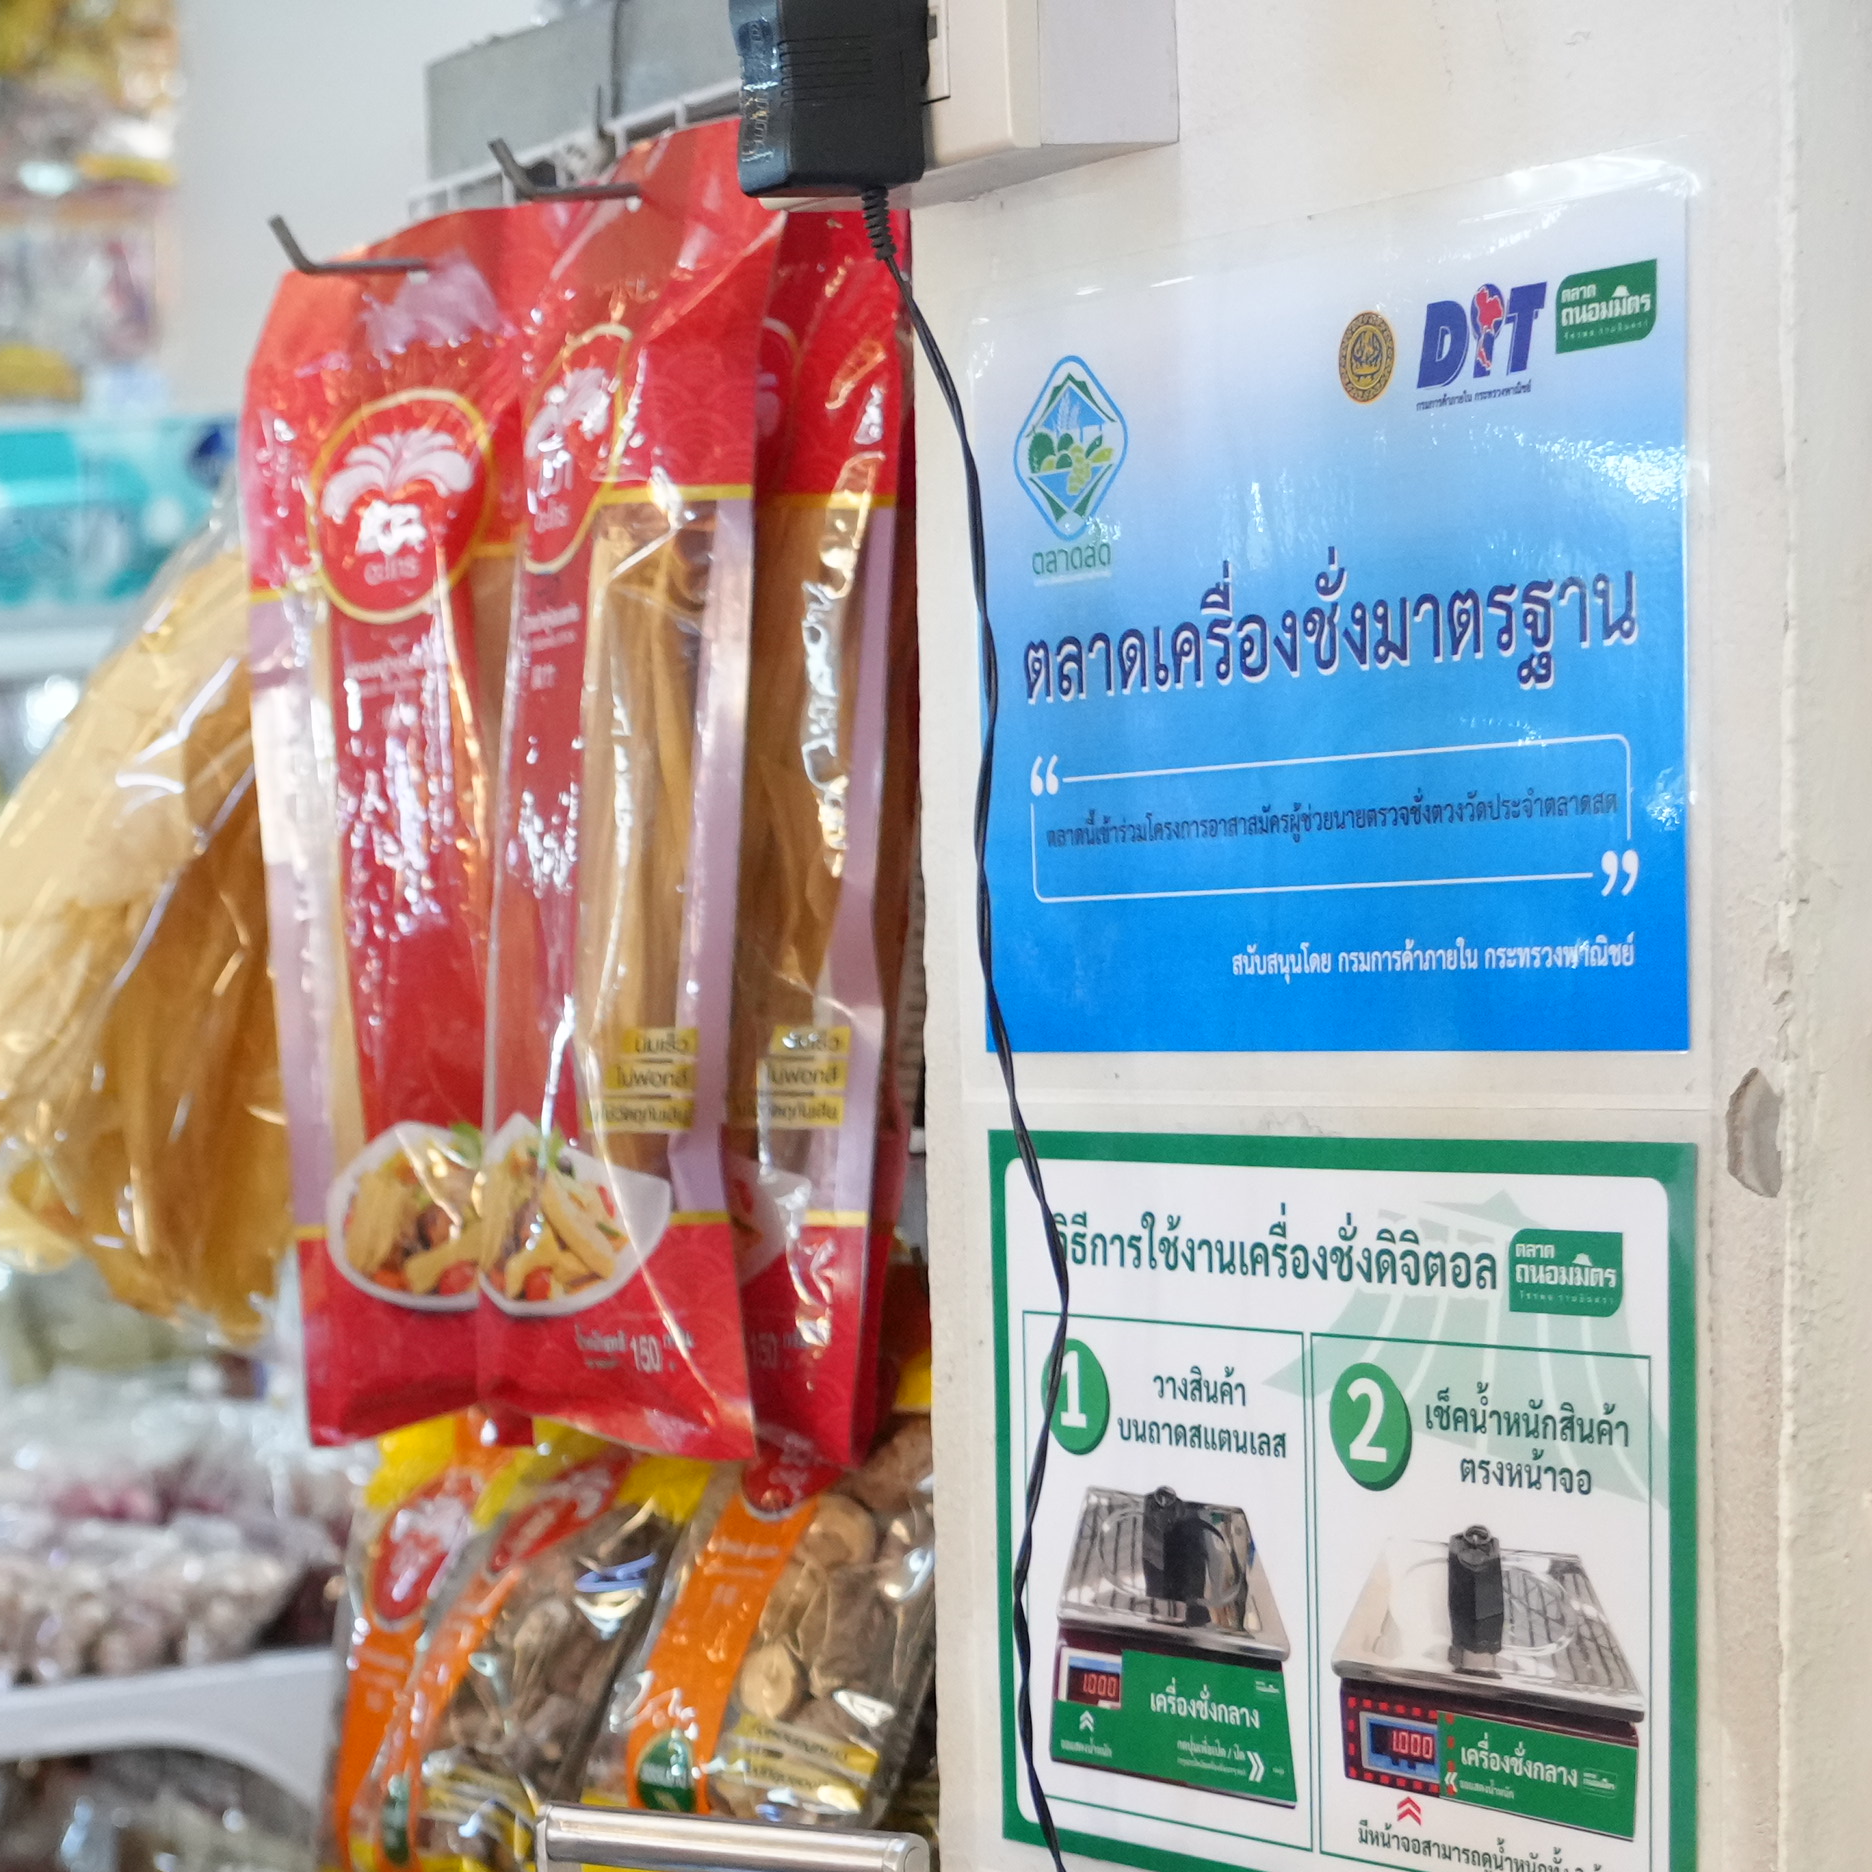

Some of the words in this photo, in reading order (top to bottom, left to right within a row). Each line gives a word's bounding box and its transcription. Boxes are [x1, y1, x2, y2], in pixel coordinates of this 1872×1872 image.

[1561, 284, 1597, 303] ตลาด
[1032, 542, 1111, 575] ตลาดสด
[1024, 546, 1637, 703] ตลาดเครื่องชั่งมาตรฐาน
[1231, 940, 1332, 984] สนับสนุนโดย
[1337, 936, 1478, 974] กรมการค้าภายใน
[1484, 932, 1634, 971] กระทรวงพาณิชย์
[1516, 1243, 1555, 1258] ตลาด
[1516, 1253, 1617, 1288] ถนอมมิตร
[1060, 1346, 1088, 1428] 1
[1152, 1366, 1247, 1407] วางสินค้า
[1118, 1416, 1287, 1459] บนถาดสแตนเลส
[1348, 1376, 1388, 1462] 2
[1426, 1383, 1630, 1448] เช็คน้ำหนักสินค้า
[1460, 1449, 1592, 1496] ตรงหน้าจอ
[1150, 1676, 1260, 1729] เครื่องชั่งกลาง
[1461, 1732, 1578, 1788] เครื่องชั่งกลาง
